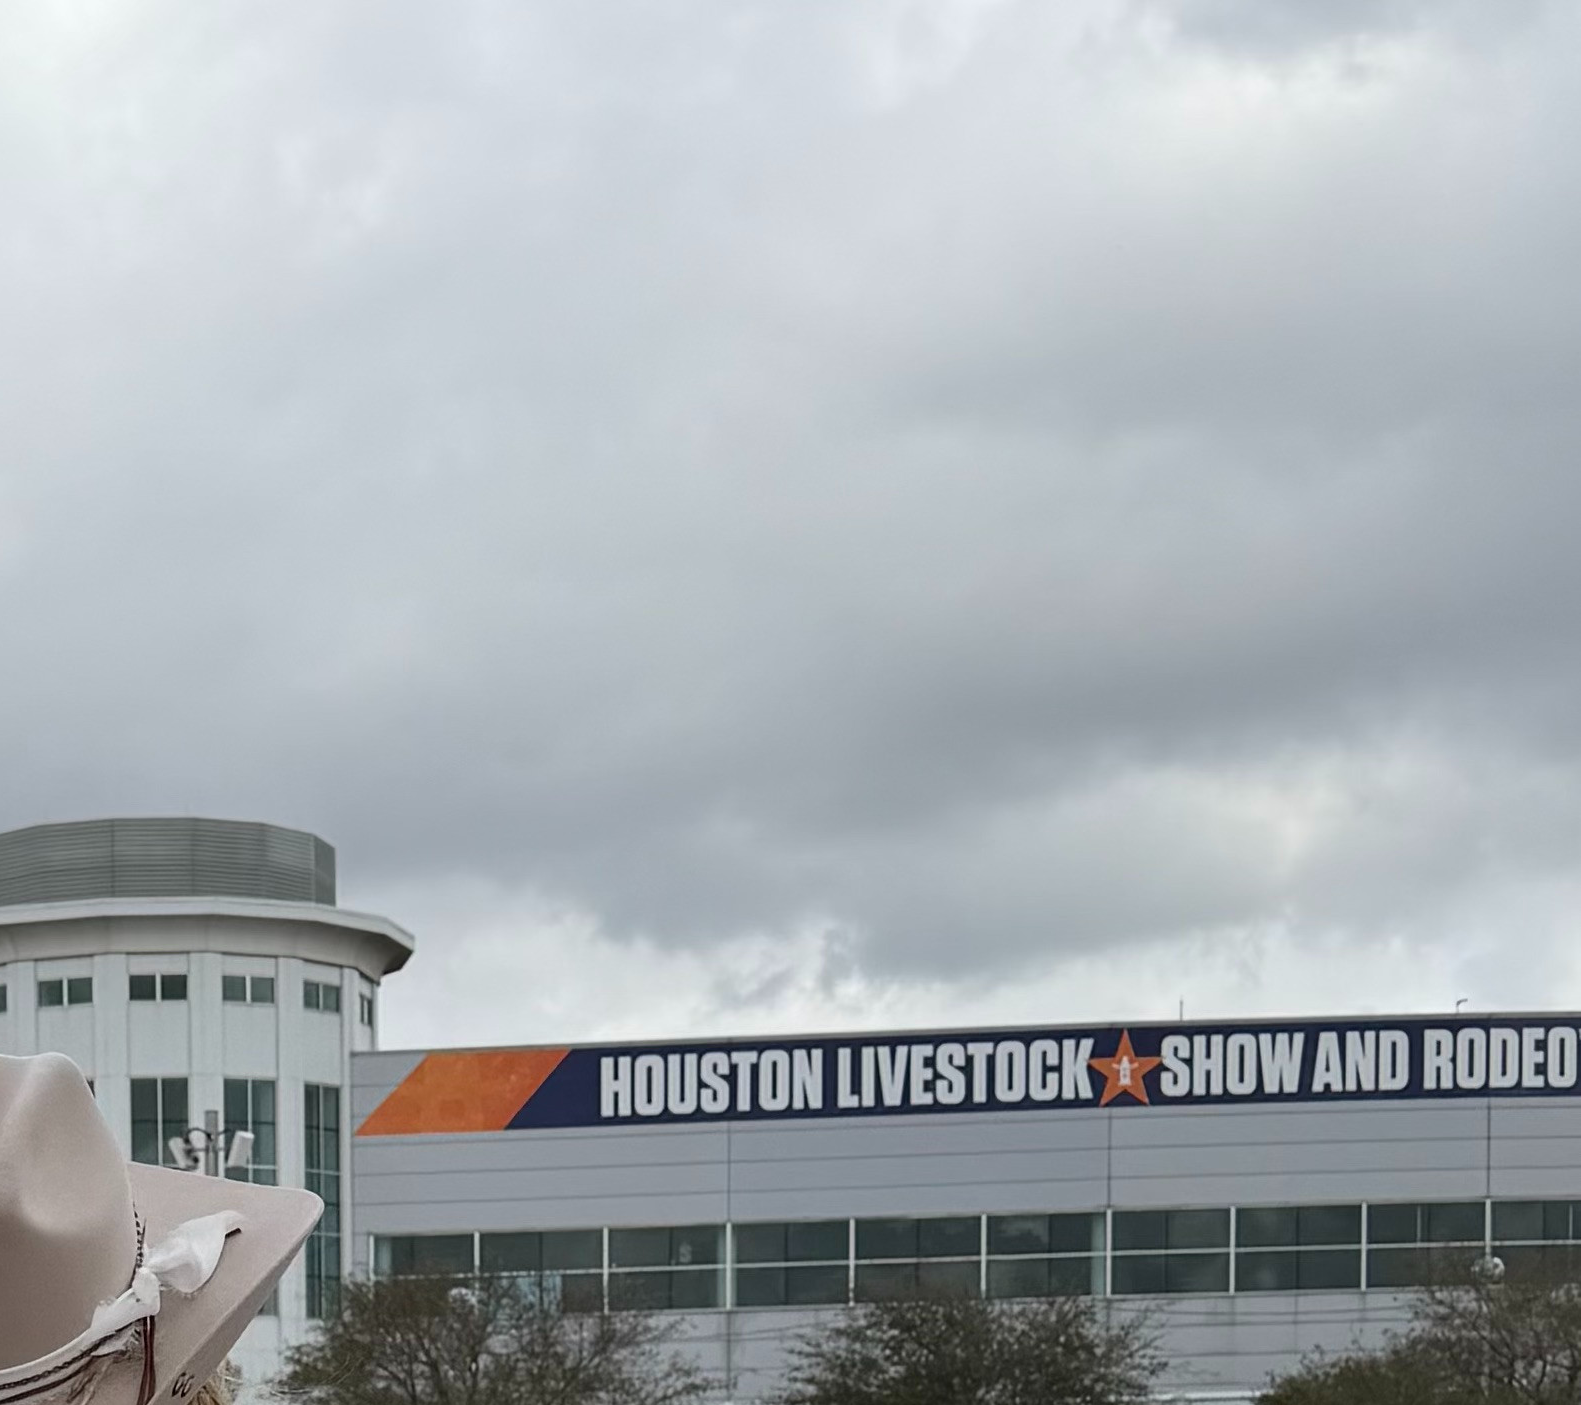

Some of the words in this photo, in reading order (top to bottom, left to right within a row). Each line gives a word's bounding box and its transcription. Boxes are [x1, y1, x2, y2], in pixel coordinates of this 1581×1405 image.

[600, 1048, 823, 1118] HOUSTON
[837, 1038, 1095, 1110] LIVESTOCK
[1160, 1032, 1305, 1097] SHOW
[1311, 1029, 1409, 1093] AND
[1423, 1026, 1577, 1090] RODEO
